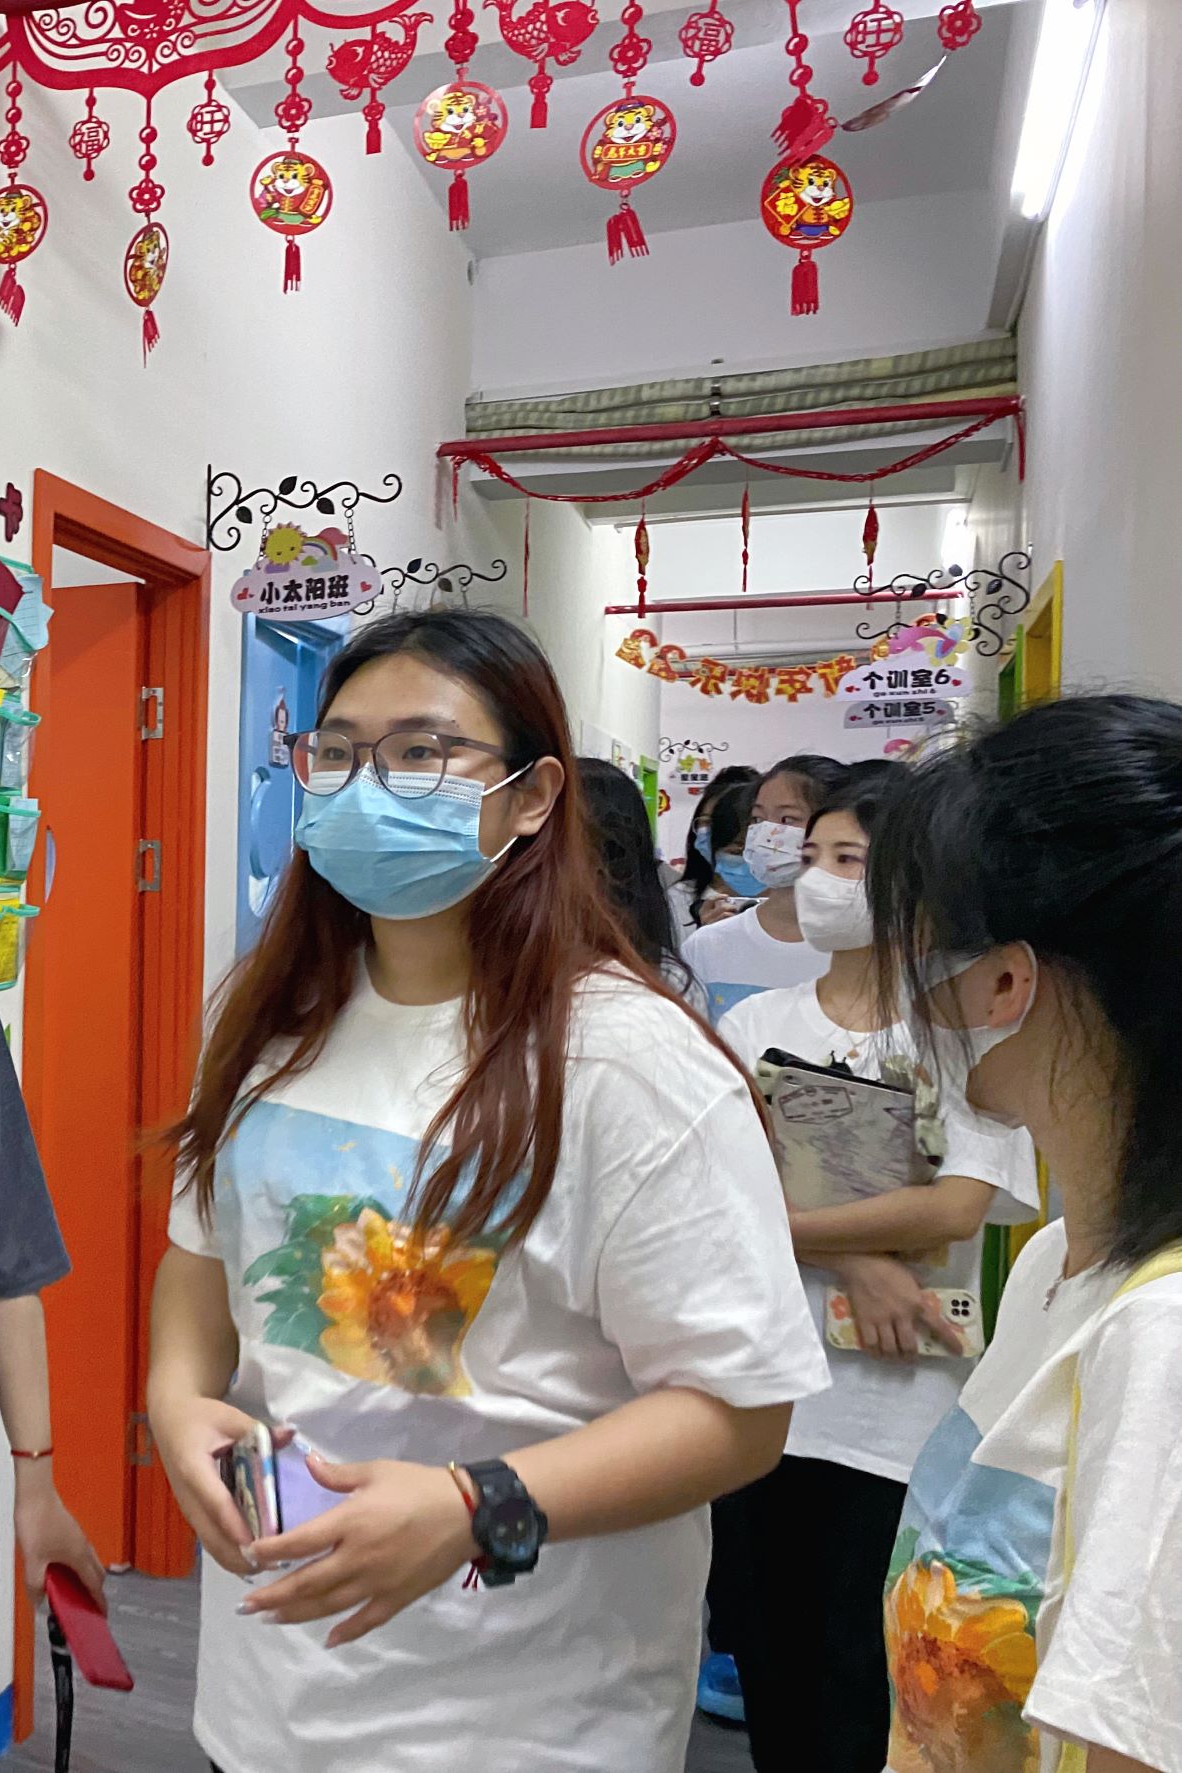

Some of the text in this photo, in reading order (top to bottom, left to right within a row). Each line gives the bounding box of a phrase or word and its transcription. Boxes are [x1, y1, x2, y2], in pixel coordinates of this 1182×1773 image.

[685, 22, 720, 55] 福
[72, 125, 102, 156] 福
[260, 574, 349, 605] 小太阳班
[300, 602, 328, 611] yang
[330, 600, 351, 608] ban
[862, 669, 951, 690] 个训室6
[863, 701, 936, 719] 个训室5
